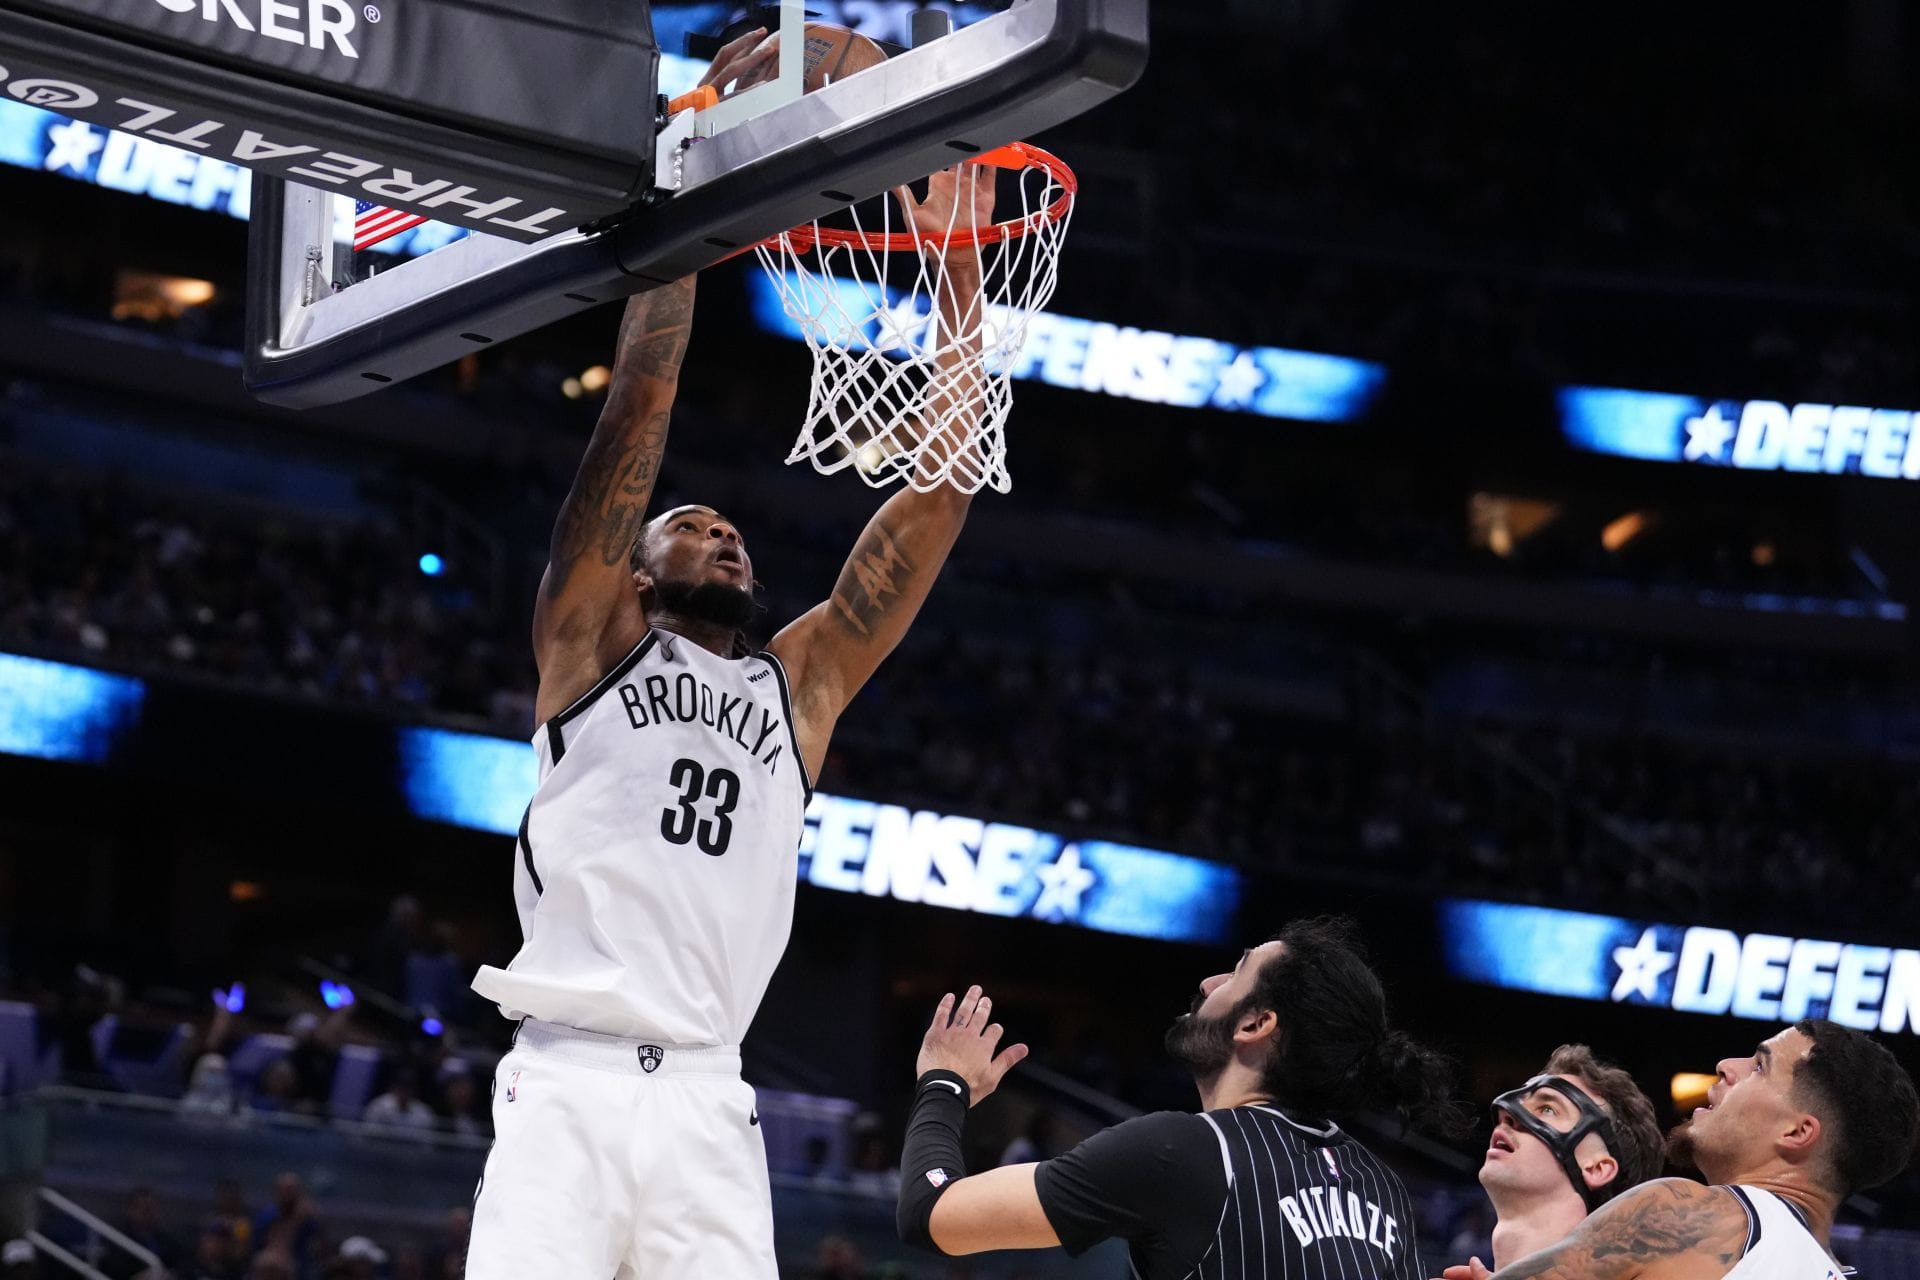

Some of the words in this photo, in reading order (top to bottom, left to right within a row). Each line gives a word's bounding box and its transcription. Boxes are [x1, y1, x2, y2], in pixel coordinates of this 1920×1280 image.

[1732, 400, 1920, 480] DEFE
[660, 758, 740, 856] 33
[640, 1047, 662, 1060] NETS
[1278, 1186, 1397, 1260] BITADZE
